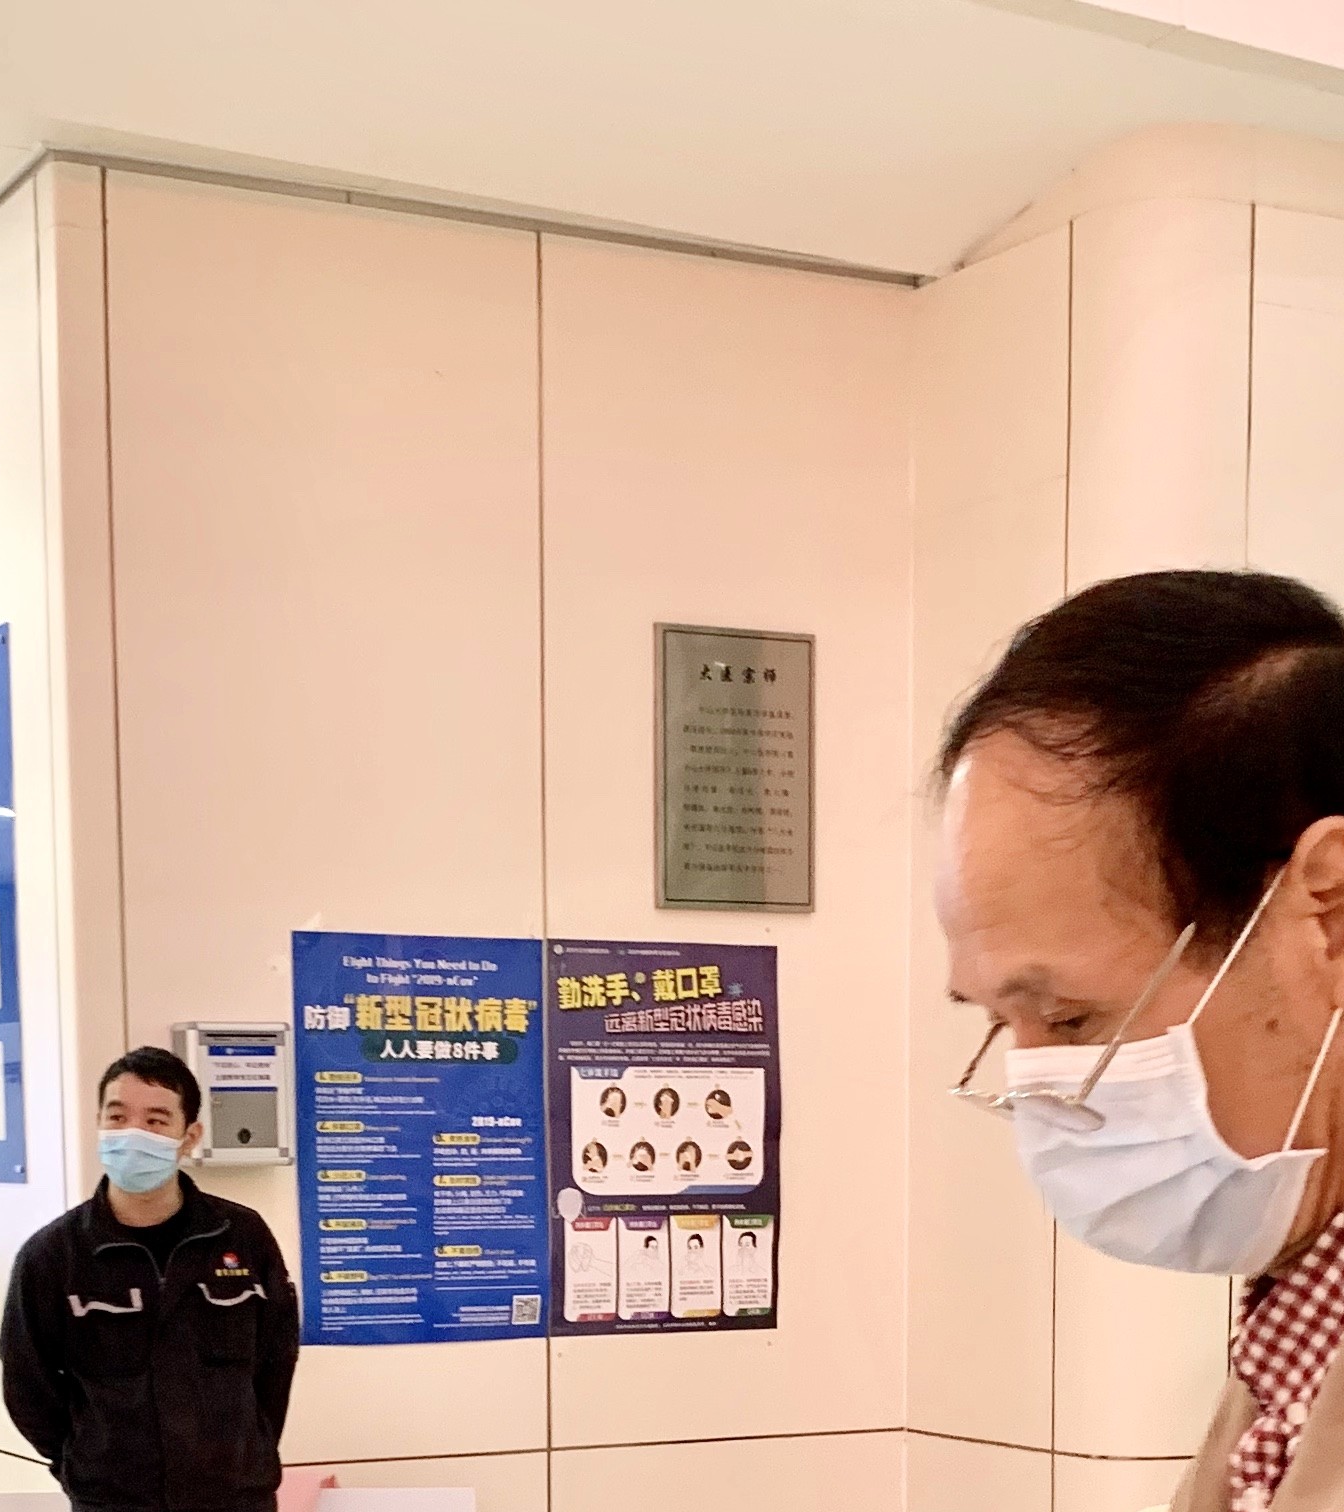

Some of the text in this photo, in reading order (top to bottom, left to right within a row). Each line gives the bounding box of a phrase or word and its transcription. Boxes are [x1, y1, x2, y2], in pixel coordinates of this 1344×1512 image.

[556, 965, 723, 1010] 勤洗手、戴口罩
[603, 998, 764, 1034] 远离新型冠状病毒感染
[380, 1039, 501, 1061] 人人要做8件事
